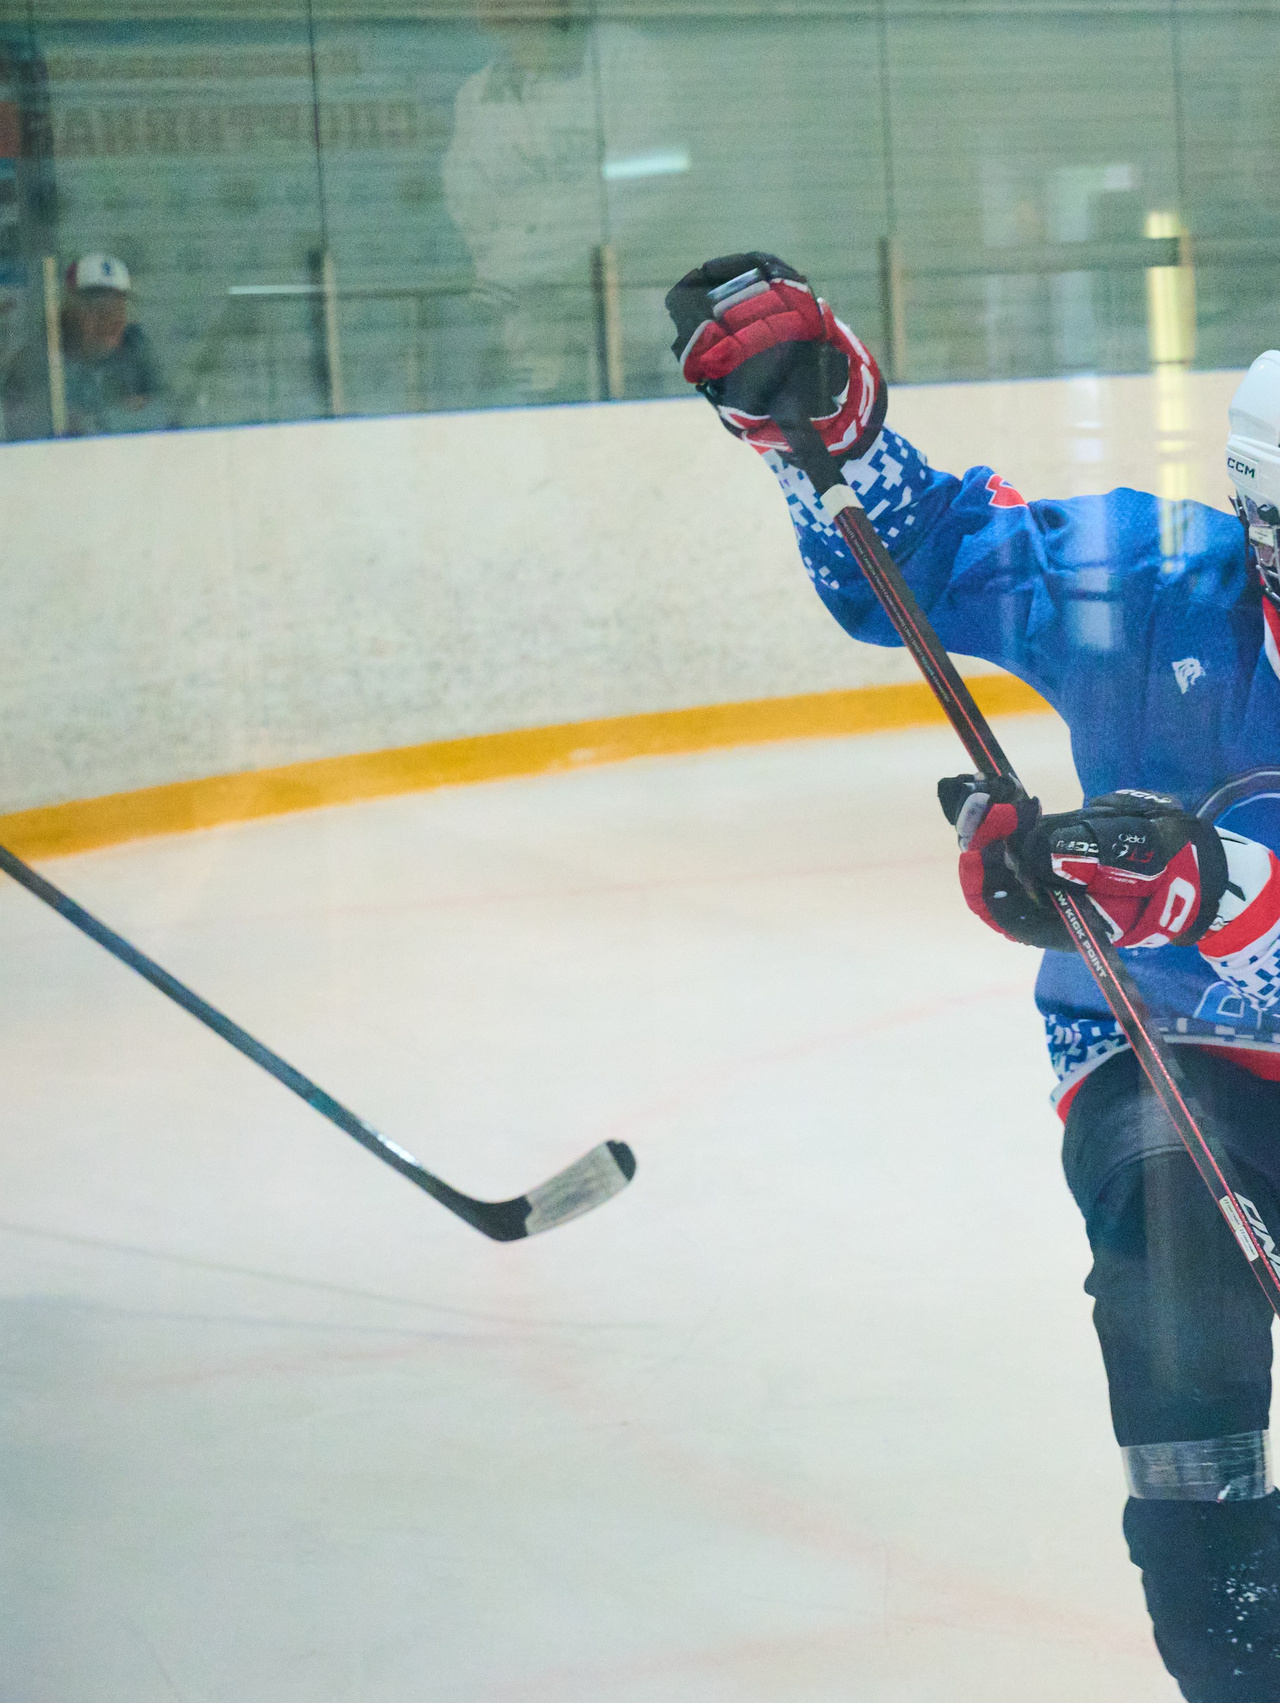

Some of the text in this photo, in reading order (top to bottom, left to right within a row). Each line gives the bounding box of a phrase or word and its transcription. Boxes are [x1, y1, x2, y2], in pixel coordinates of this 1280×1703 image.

[1227, 457, 1256, 479] CCM
[1065, 908, 1086, 940] KICK
[1082, 940, 1107, 978] POINT
